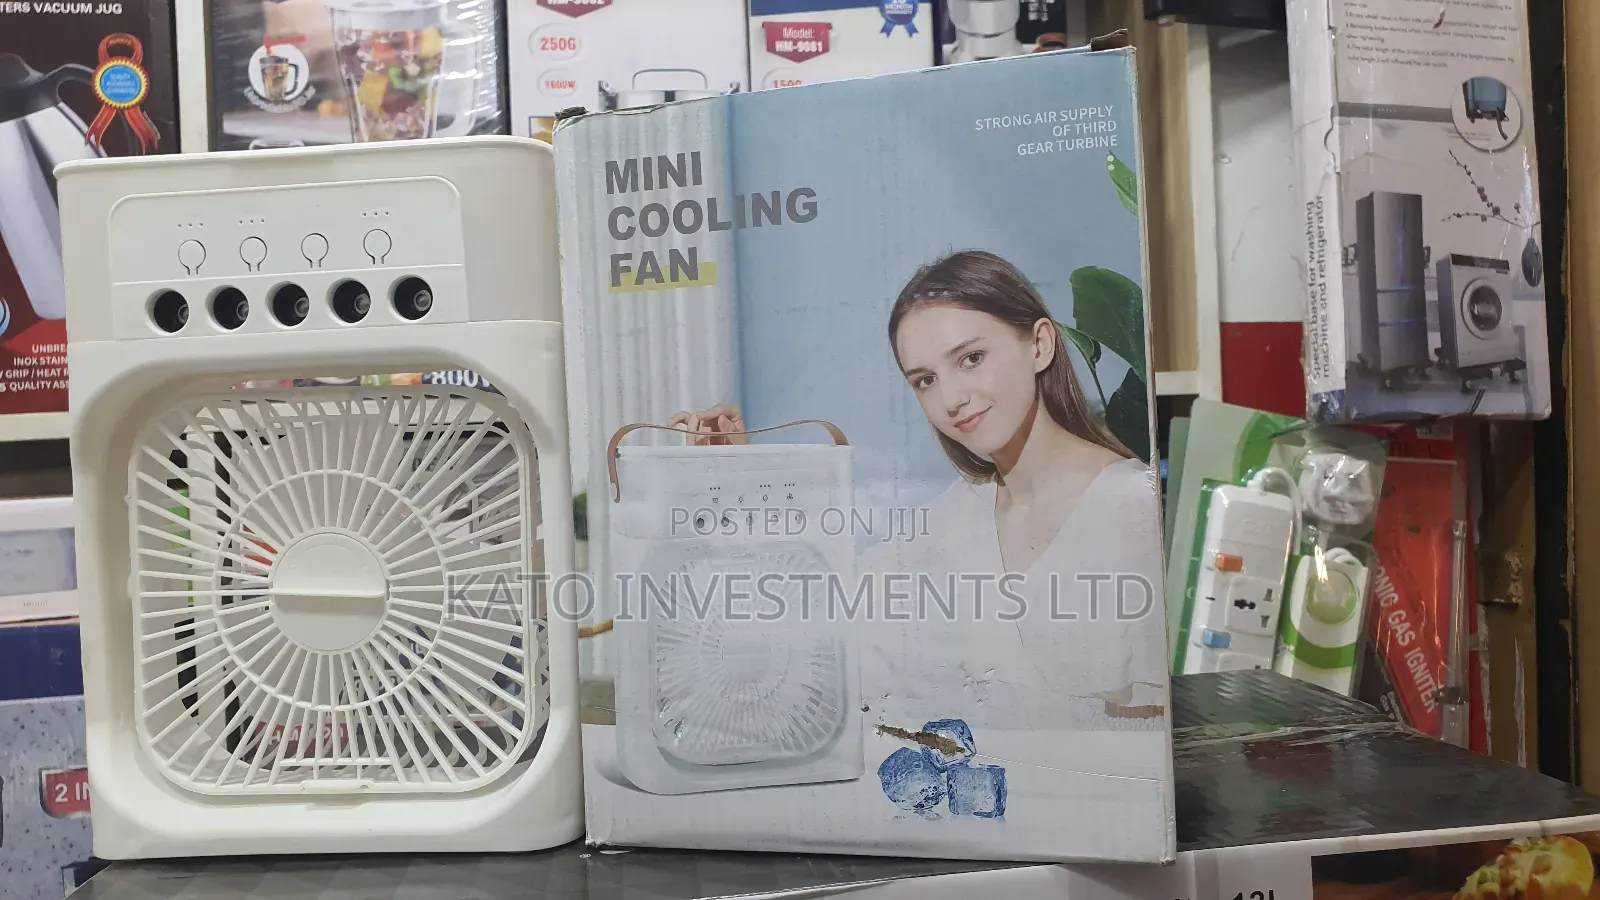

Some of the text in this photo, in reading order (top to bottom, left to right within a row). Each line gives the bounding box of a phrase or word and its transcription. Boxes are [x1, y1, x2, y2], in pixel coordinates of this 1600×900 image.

[33, 2, 92, 14] VACUUM
[95, 3, 122, 14] JUG
[541, 37, 577, 51] 250G
[975, 105, 1113, 131] STRONG AIR SUPPLY
[1053, 120, 1117, 137] OF THIRD
[1017, 135, 1117, 155] GEAR TURBINE
[605, 151, 703, 194] MINI
[607, 187, 818, 241] COOLING
[1305, 200, 1316, 263] washing
[610, 246, 699, 287] FAN
[1308, 266, 1317, 287] for
[1316, 195, 1331, 378] machine and refrigerator
[1309, 290, 1318, 324] base
[32, 343, 68, 354] UNBRE
[13, 356, 38, 366] INOX
[5, 368, 29, 379] GRIP
[37, 367, 61, 378] HEAT
[10, 380, 51, 393] QUALITY
[1388, 609, 1416, 647] GAS
[55, 782, 69, 803] 2
